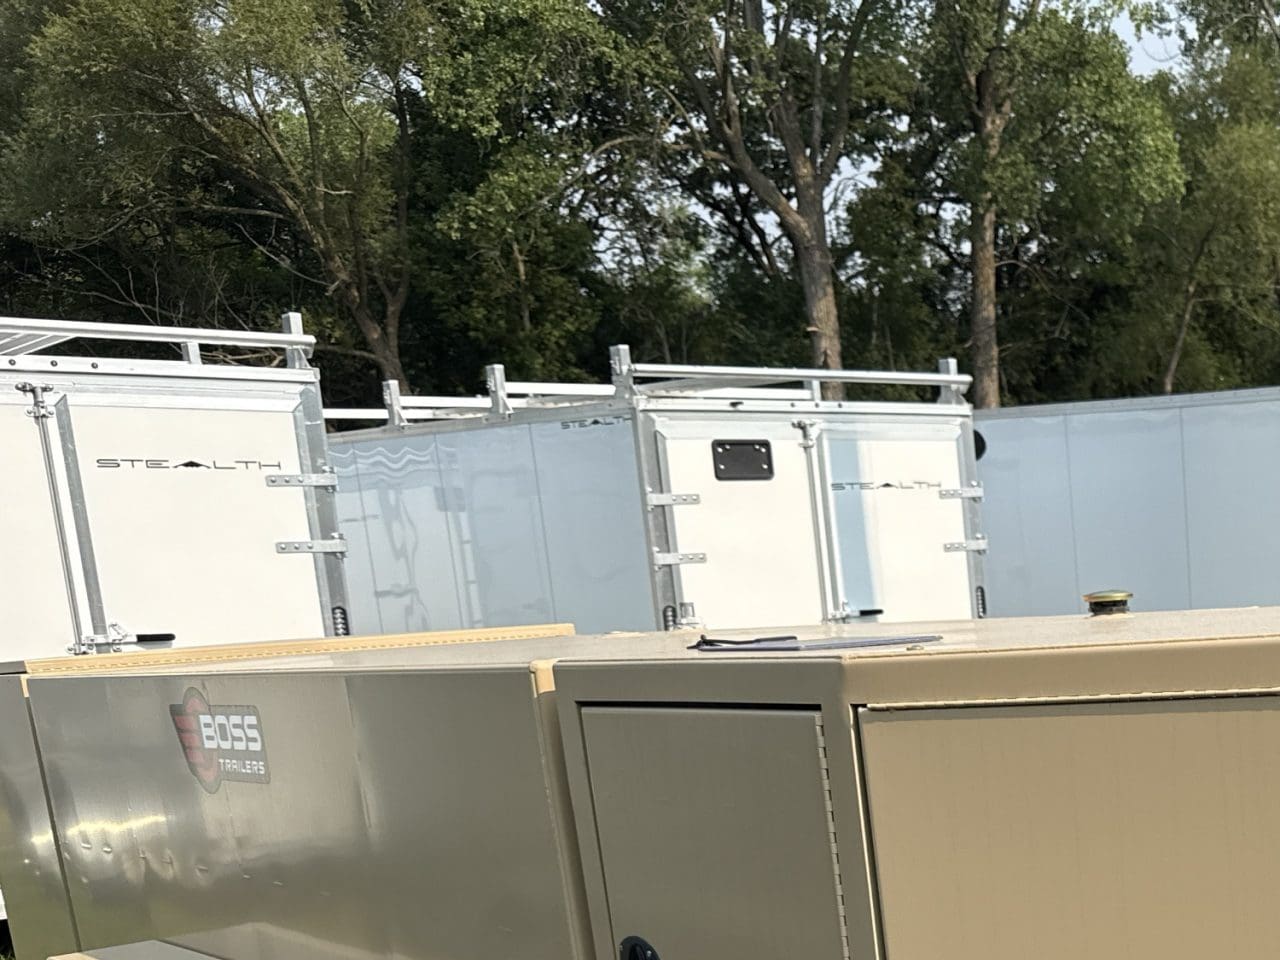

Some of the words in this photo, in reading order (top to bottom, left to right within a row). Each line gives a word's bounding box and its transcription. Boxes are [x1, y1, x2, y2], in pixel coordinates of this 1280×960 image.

[96, 458, 282, 471] STEALTH
[830, 481, 941, 491] STEALTH
[199, 714, 262, 751] BOSS
[218, 758, 265, 774] TRAILERS
